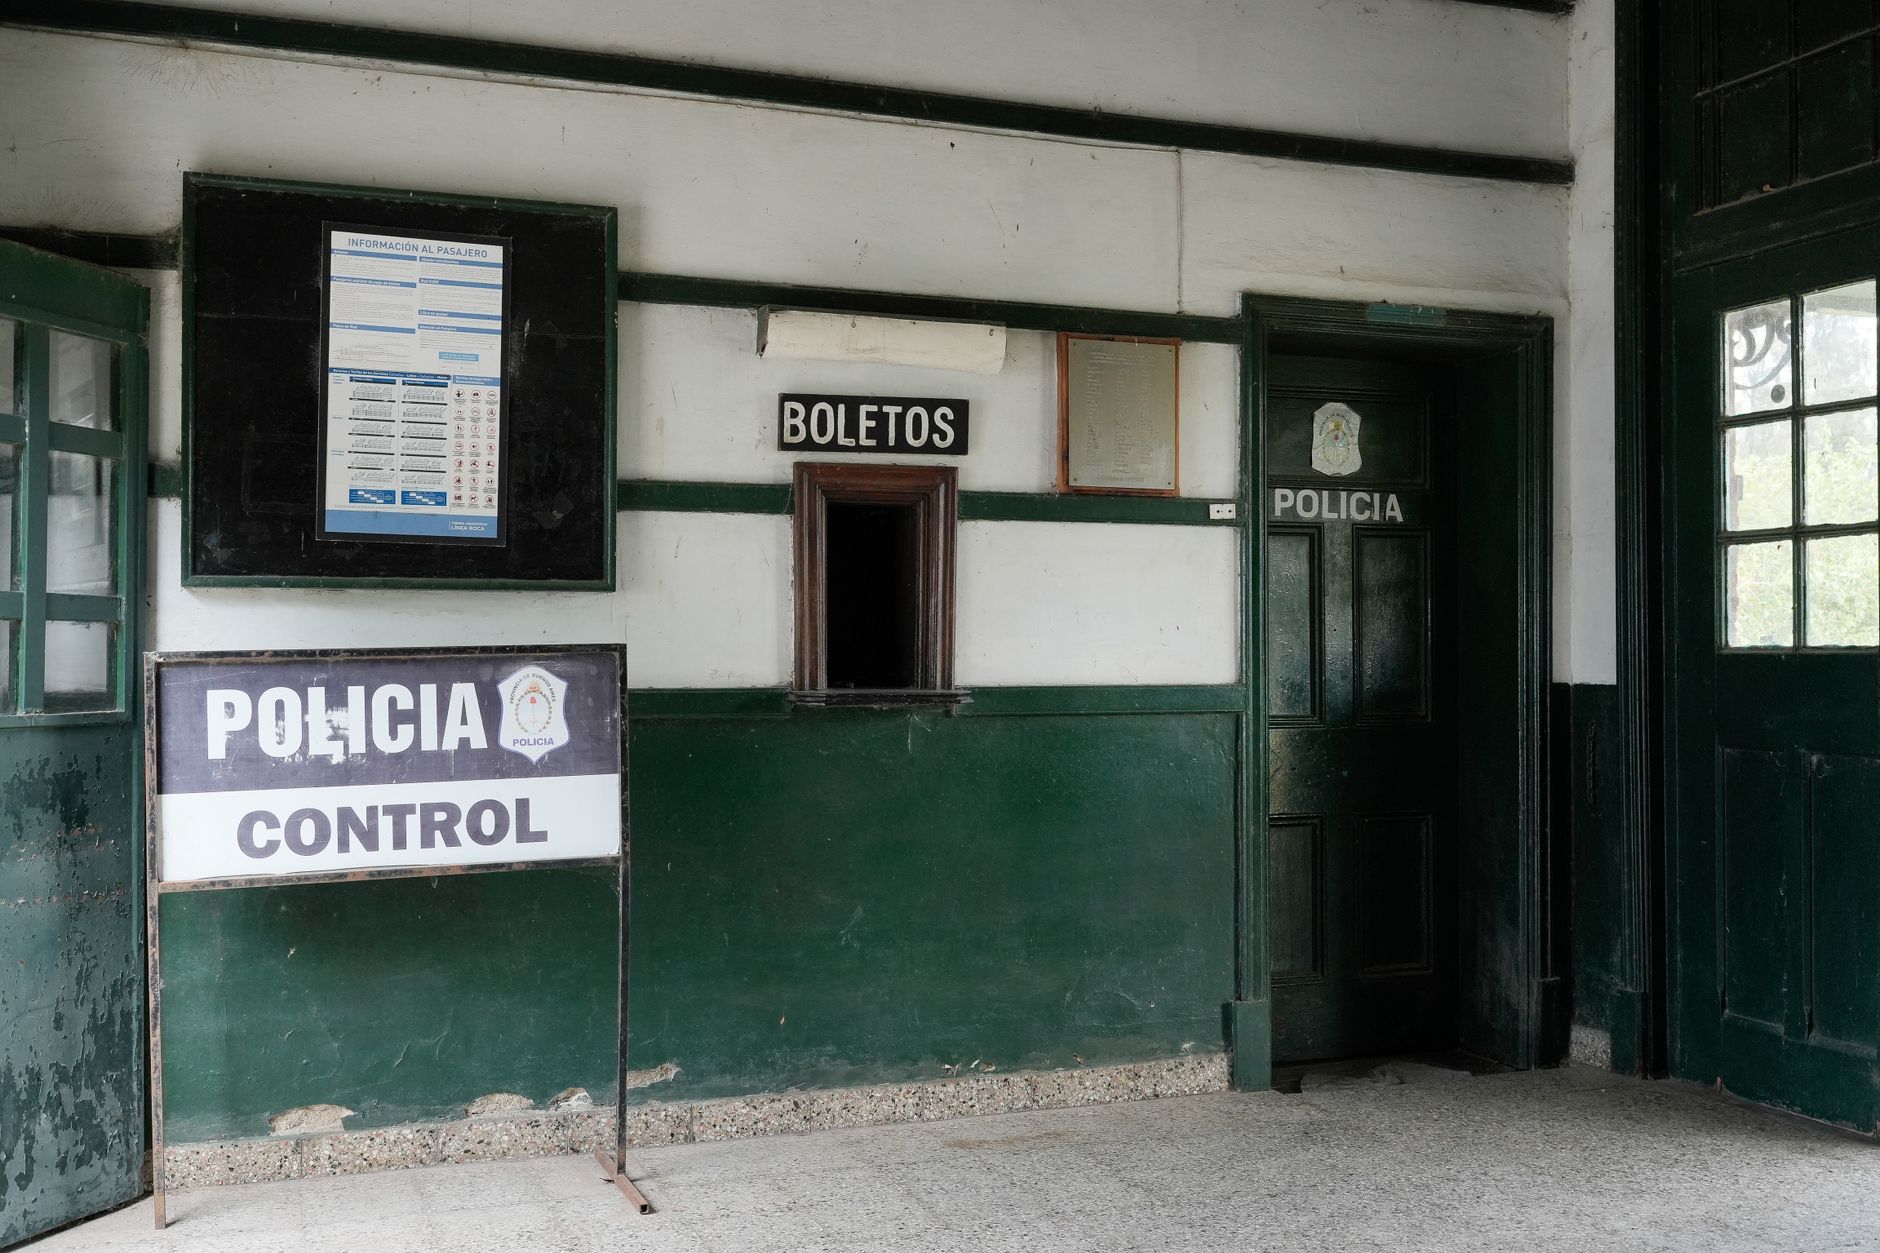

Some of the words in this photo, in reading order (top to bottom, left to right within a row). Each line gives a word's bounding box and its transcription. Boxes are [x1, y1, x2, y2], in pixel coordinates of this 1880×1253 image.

[348, 238, 418, 252] INFORMACIÓN
[421, 244, 434, 254] AL
[437, 246, 488, 258] PASAJERO
[783, 401, 955, 449] BOLETOS
[1274, 488, 1404, 522] POLICIA
[510, 679, 523, 704] PROVINCIA
[532, 673, 551, 688] BUENOS
[206, 682, 488, 760] POLICIA
[512, 737, 555, 747] POLICIA
[236, 797, 548, 859] CONTROL
